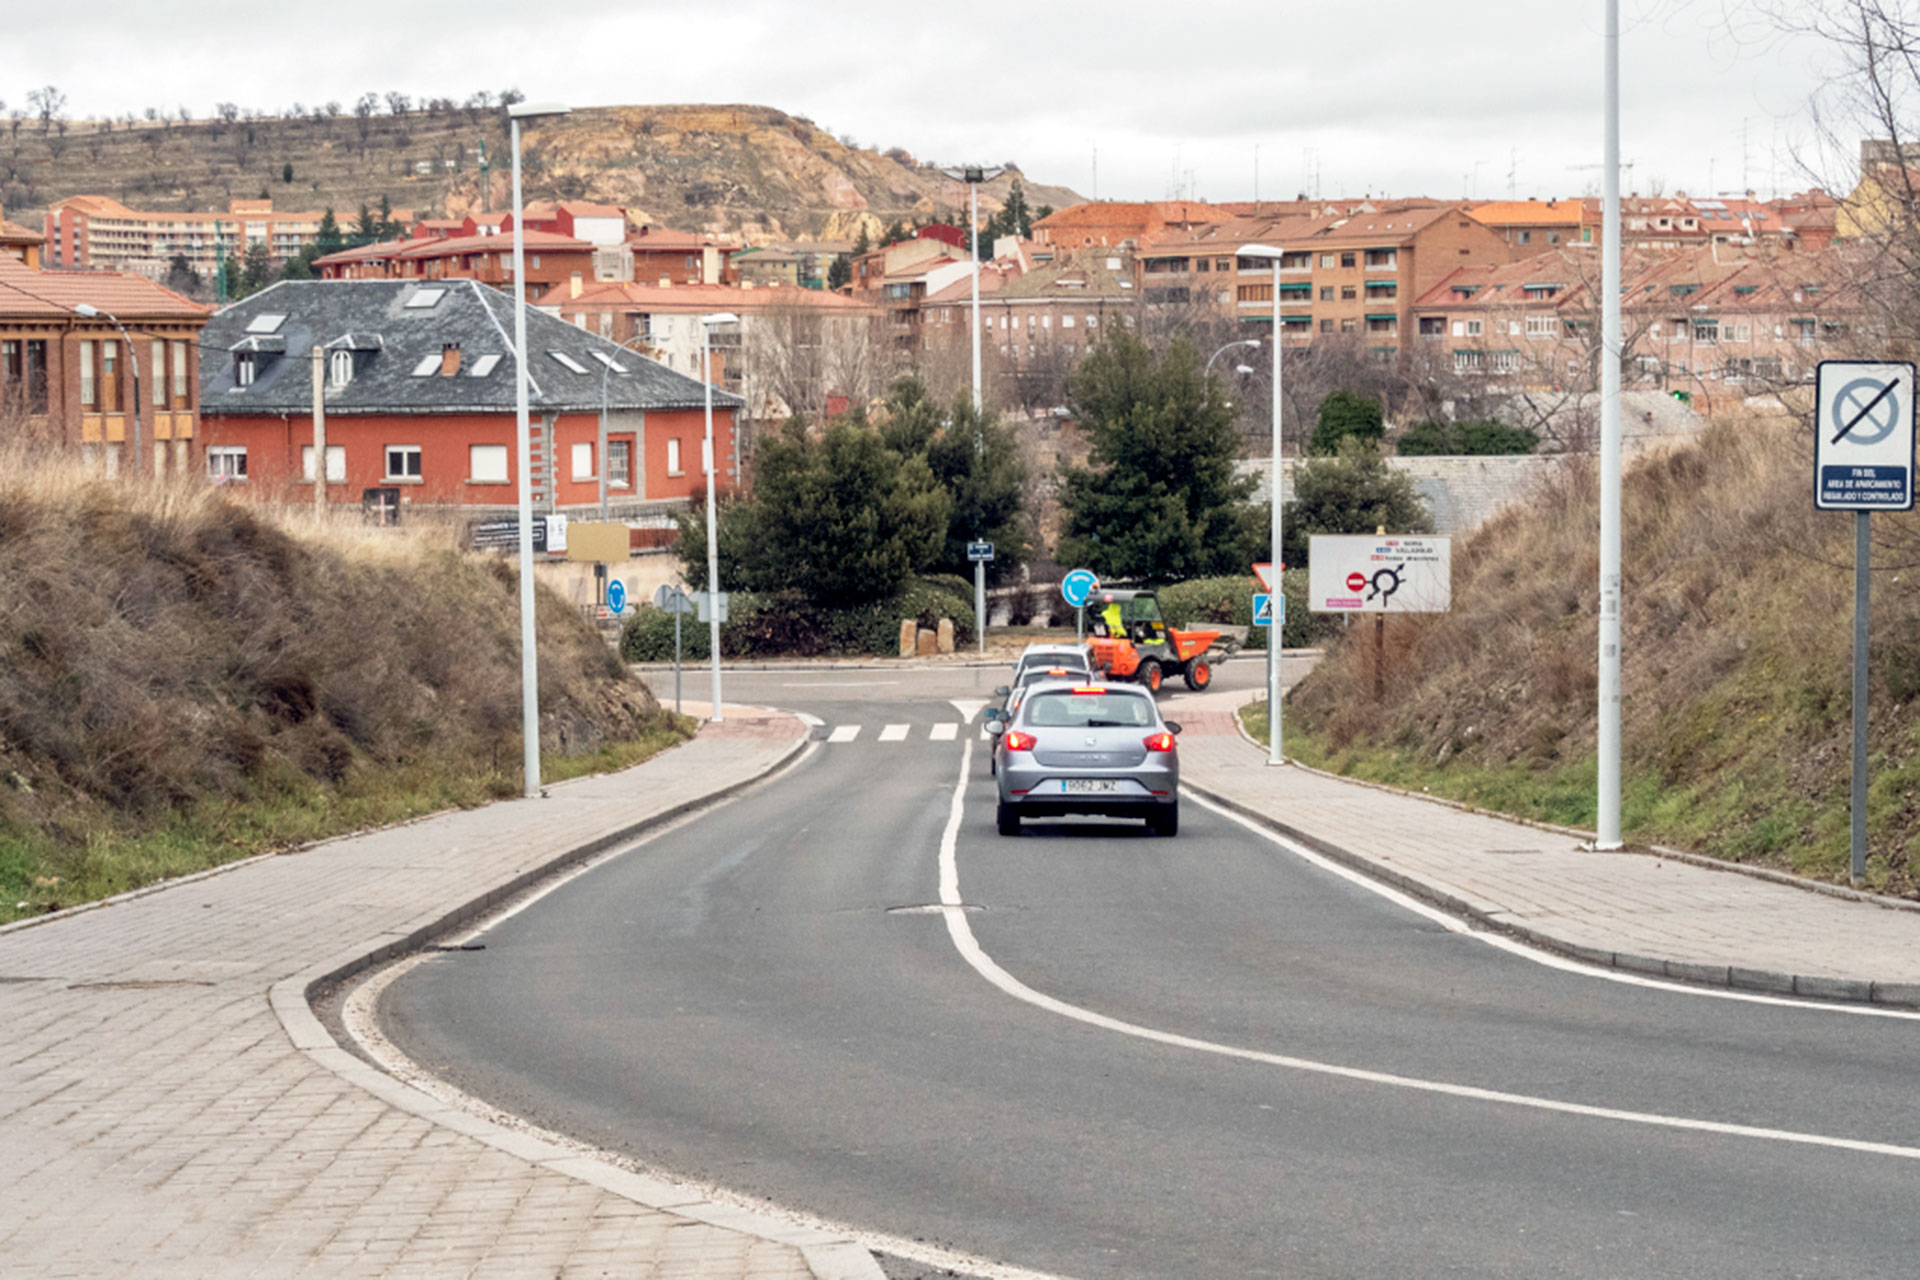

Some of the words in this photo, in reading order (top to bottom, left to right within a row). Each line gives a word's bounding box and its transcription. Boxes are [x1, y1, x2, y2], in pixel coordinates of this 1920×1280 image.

[1851, 468, 1863, 477] FIN
[1863, 468, 1876, 477] DEL
[1845, 480, 1854, 489] DE
[1855, 480, 1902, 489] APARCAMIENTO
[1862, 492, 1904, 501] CONTROLADO
